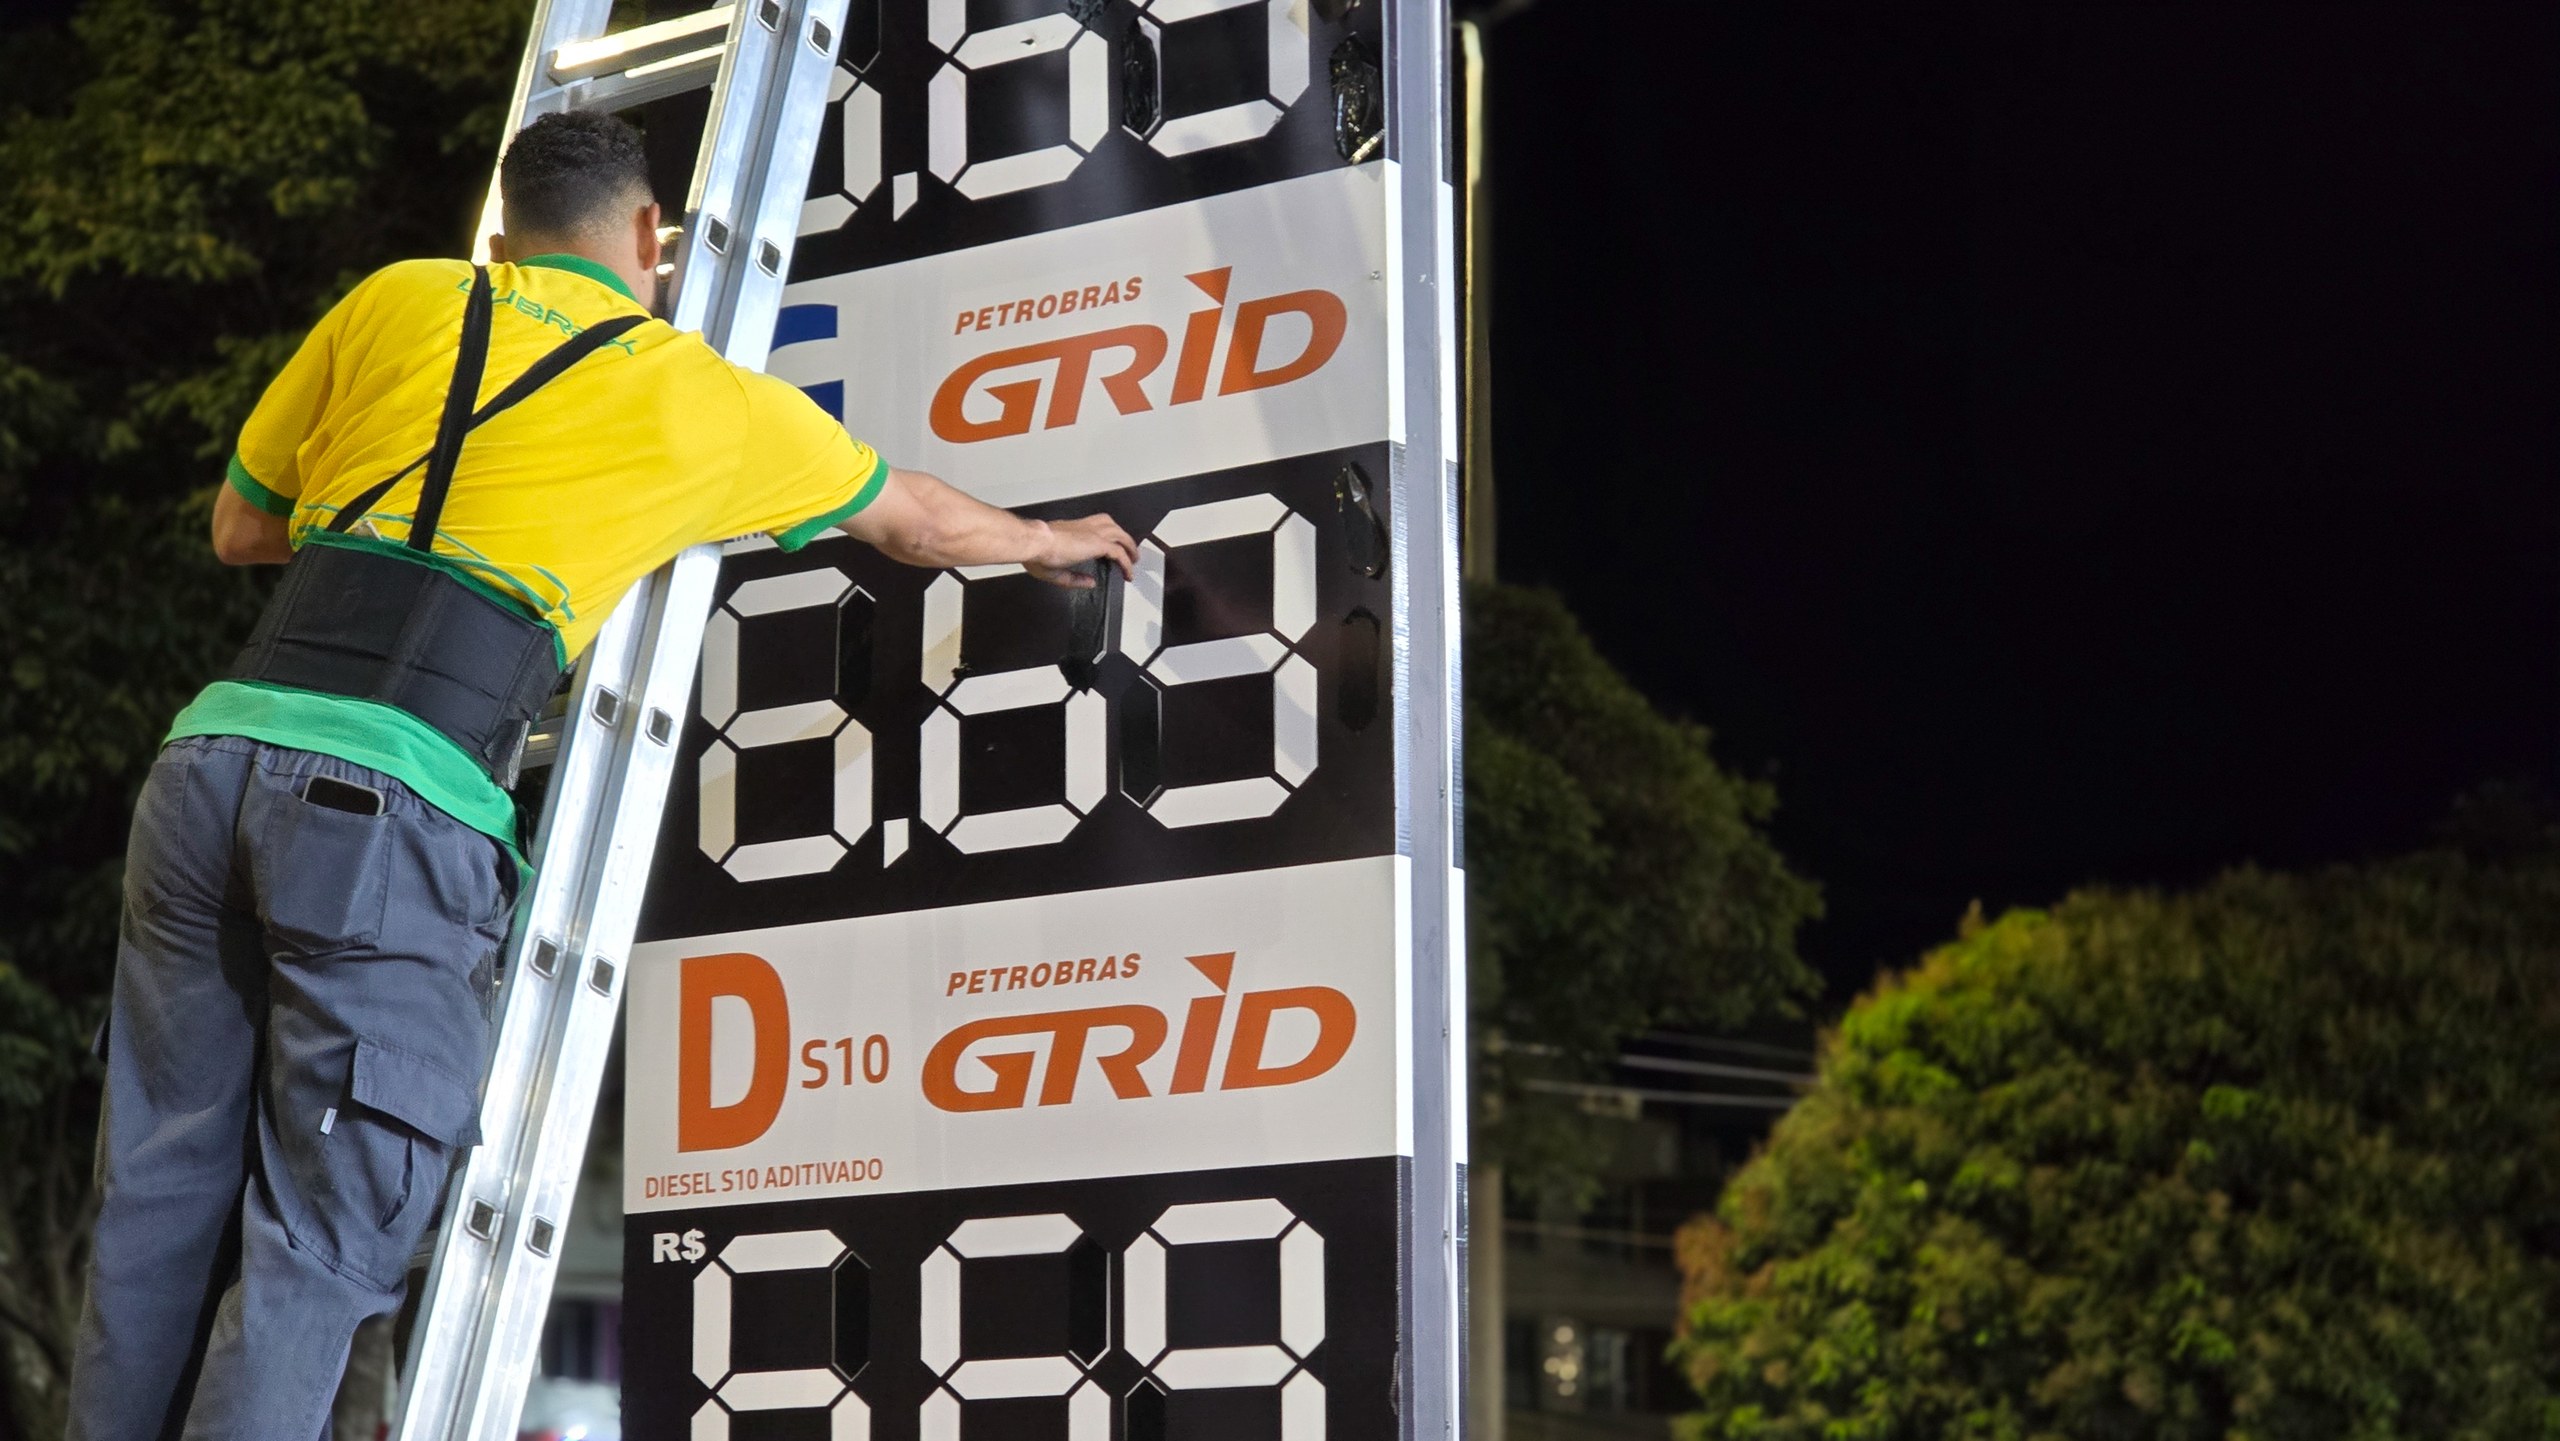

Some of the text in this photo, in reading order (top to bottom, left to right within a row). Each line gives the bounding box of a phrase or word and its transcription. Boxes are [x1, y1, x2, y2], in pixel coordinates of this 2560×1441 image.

[456, 278, 638, 356] LUBRX
[955, 276, 1143, 335] PETROBRAS
[928, 266, 1348, 444] GRID
[946, 952, 1142, 997] PETROBRAS
[677, 952, 890, 1154] D S10
[921, 952, 1358, 1113] GRID
[645, 1158, 883, 1199] DIESEL S10 ADITIVADO
[653, 1228, 706, 1264] R$
